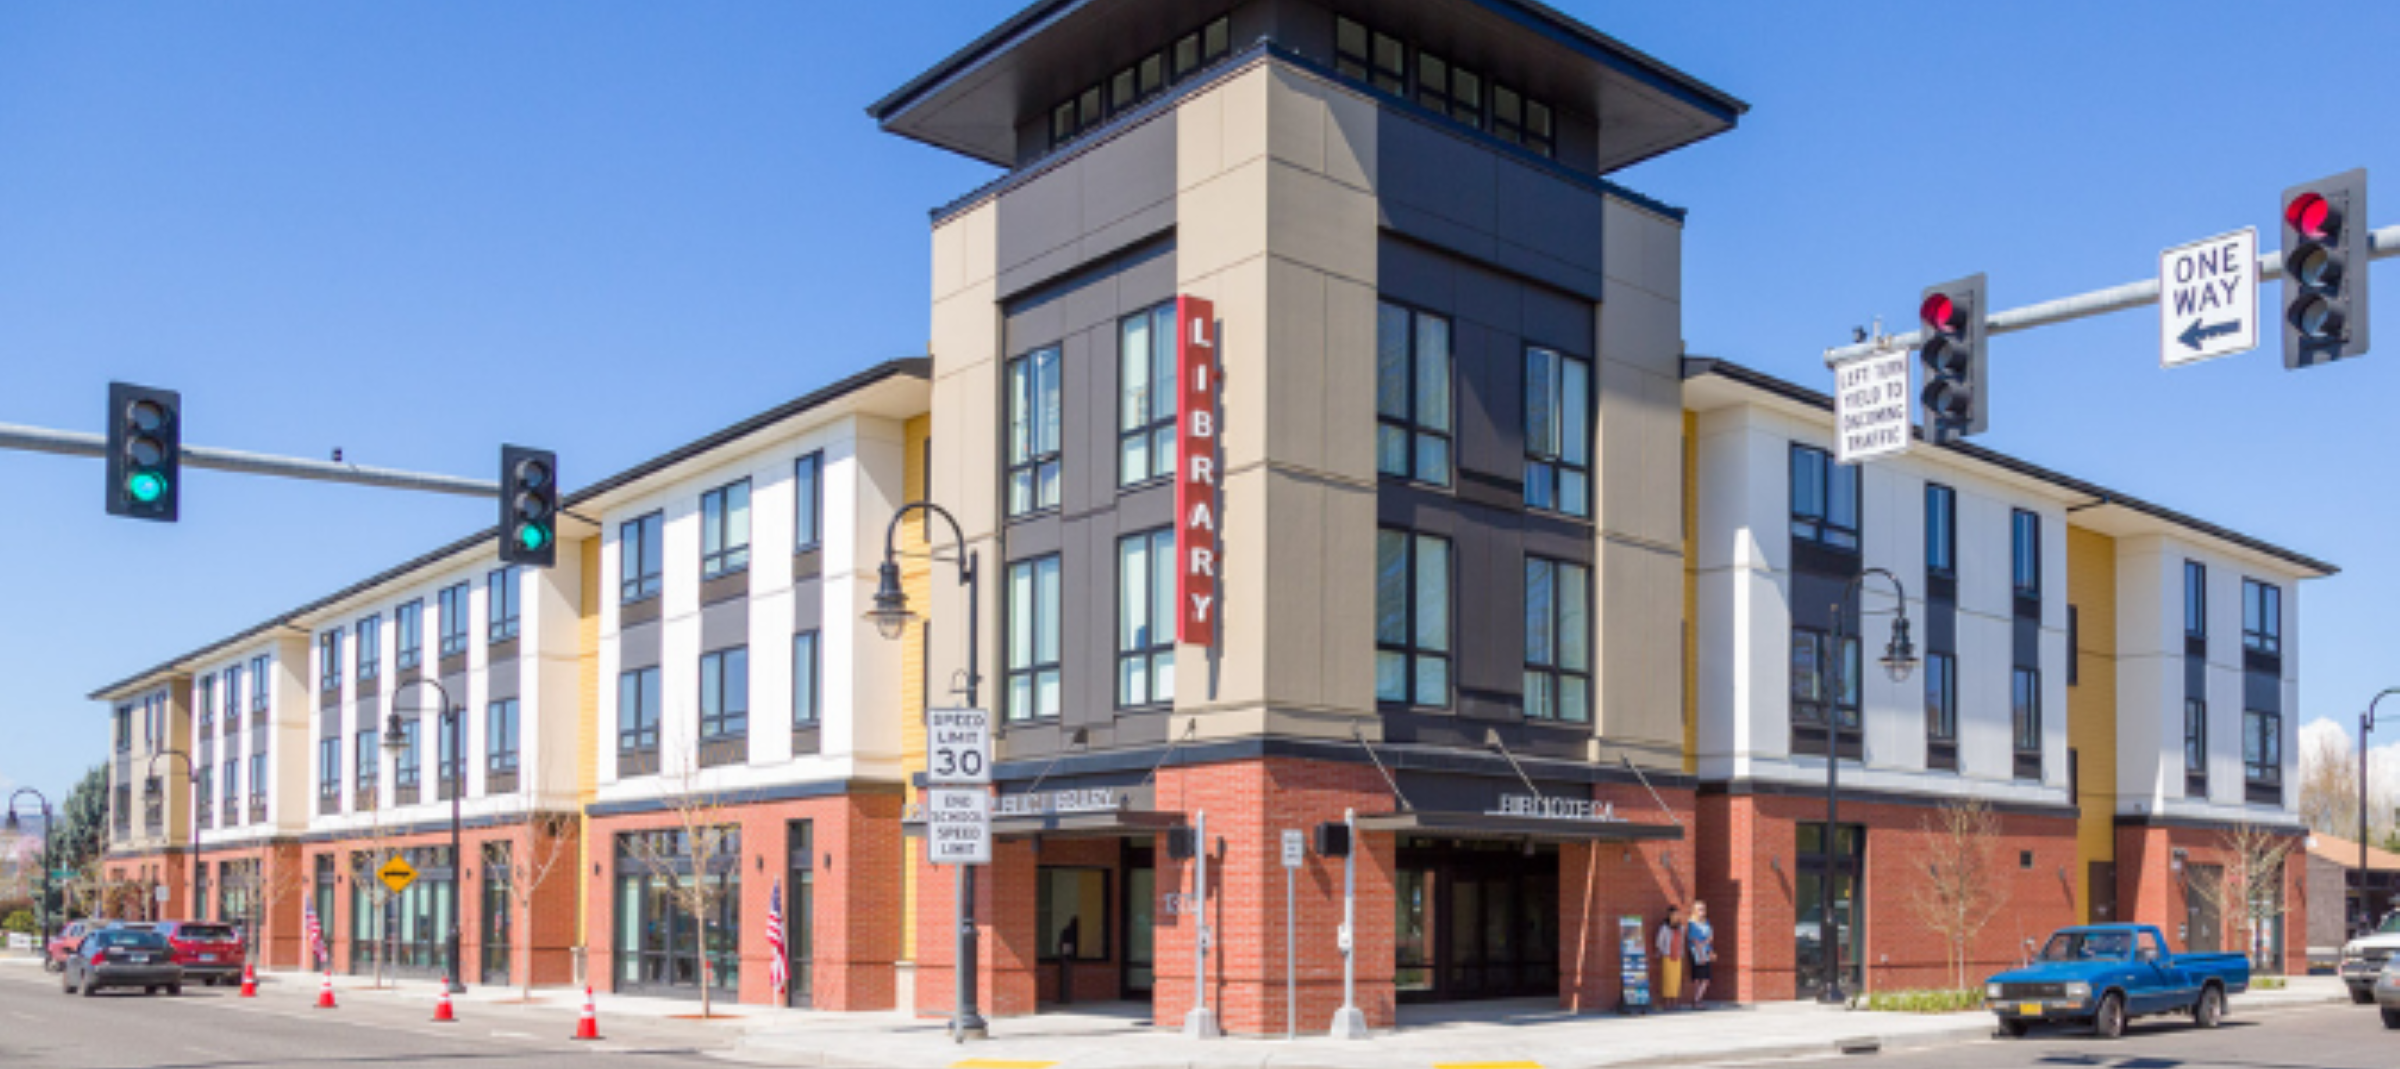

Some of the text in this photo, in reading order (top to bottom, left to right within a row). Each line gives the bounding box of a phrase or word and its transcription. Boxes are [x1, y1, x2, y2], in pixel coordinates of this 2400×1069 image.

[2175, 242, 2240, 283] ONE
[2173, 275, 2241, 317] WAY
[1841, 367, 1867, 390] LEFT
[1845, 382, 1903, 408] YIELD TO
[1845, 404, 1903, 432] ONCOMING
[1846, 425, 1900, 451] TRAFFIC
[1188, 317, 1213, 622] LIBRARY
[933, 713, 985, 727] SPEED
[937, 732, 978, 744] LIMIT
[934, 748, 982, 776] 30
[944, 795, 972, 808] END
[932, 811, 983, 823] SCHOOL
[937, 826, 981, 840] SPEED
[941, 843, 976, 855] LIMIT
